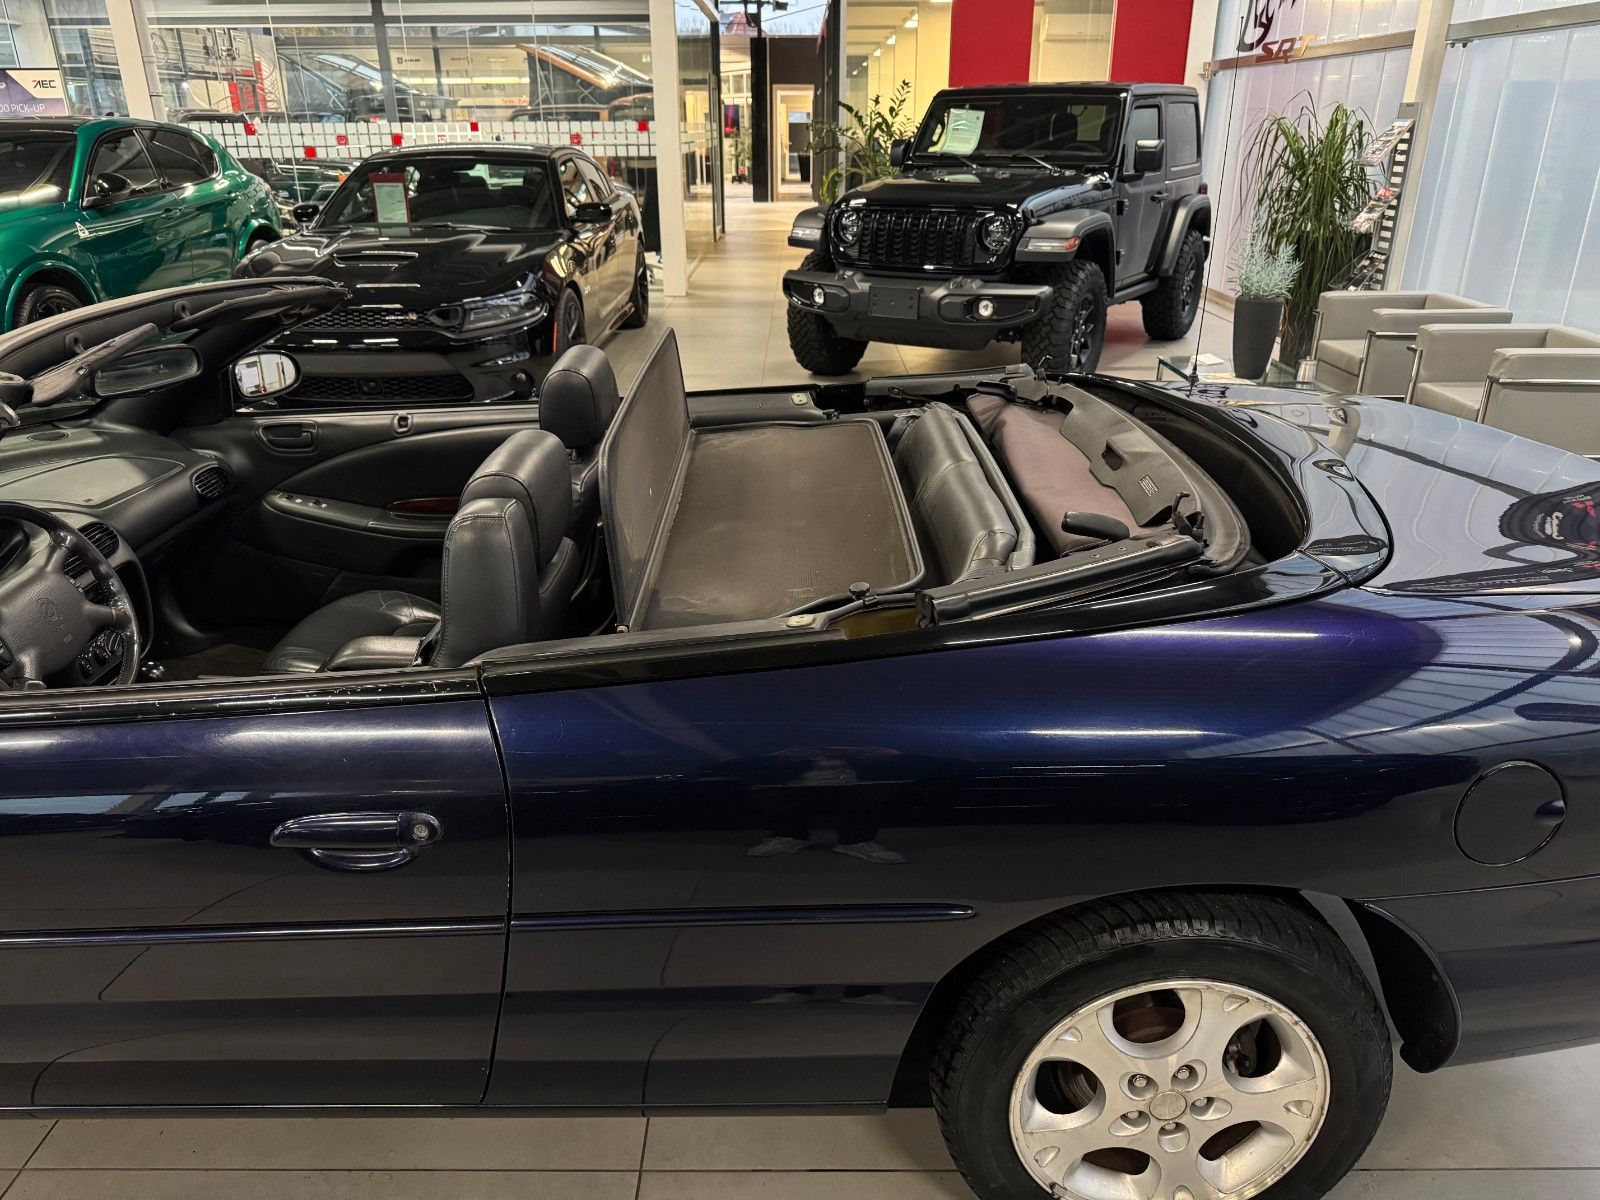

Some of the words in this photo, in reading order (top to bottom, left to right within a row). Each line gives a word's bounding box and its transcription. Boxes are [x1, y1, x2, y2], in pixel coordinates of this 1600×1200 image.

[1255, 34, 1319, 64] SRT
[31, 79, 57, 89] AEC
[11, 103, 46, 113] PICK-UP
